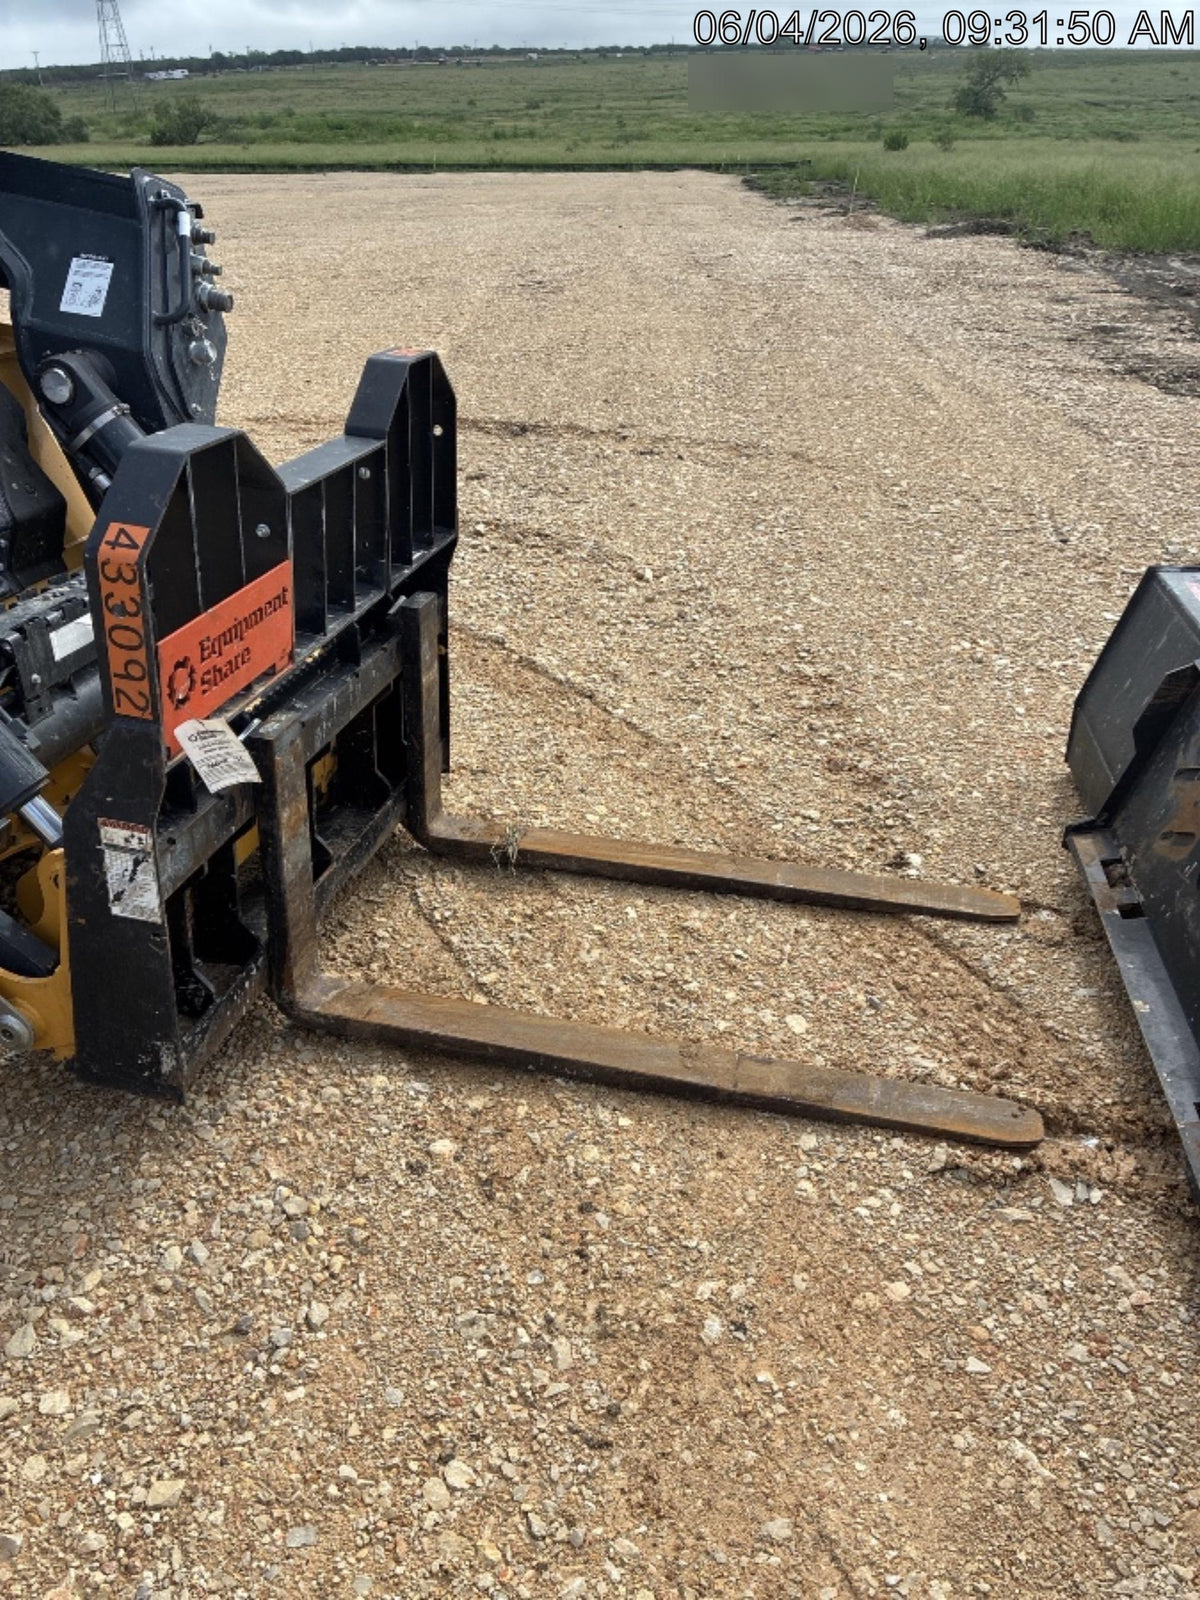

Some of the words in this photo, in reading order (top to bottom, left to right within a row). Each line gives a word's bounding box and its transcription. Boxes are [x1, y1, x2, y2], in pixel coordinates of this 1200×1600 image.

[101, 527, 151, 716] 433092
[199, 586, 288, 663] Equipment
[200, 646, 251, 695] Share
